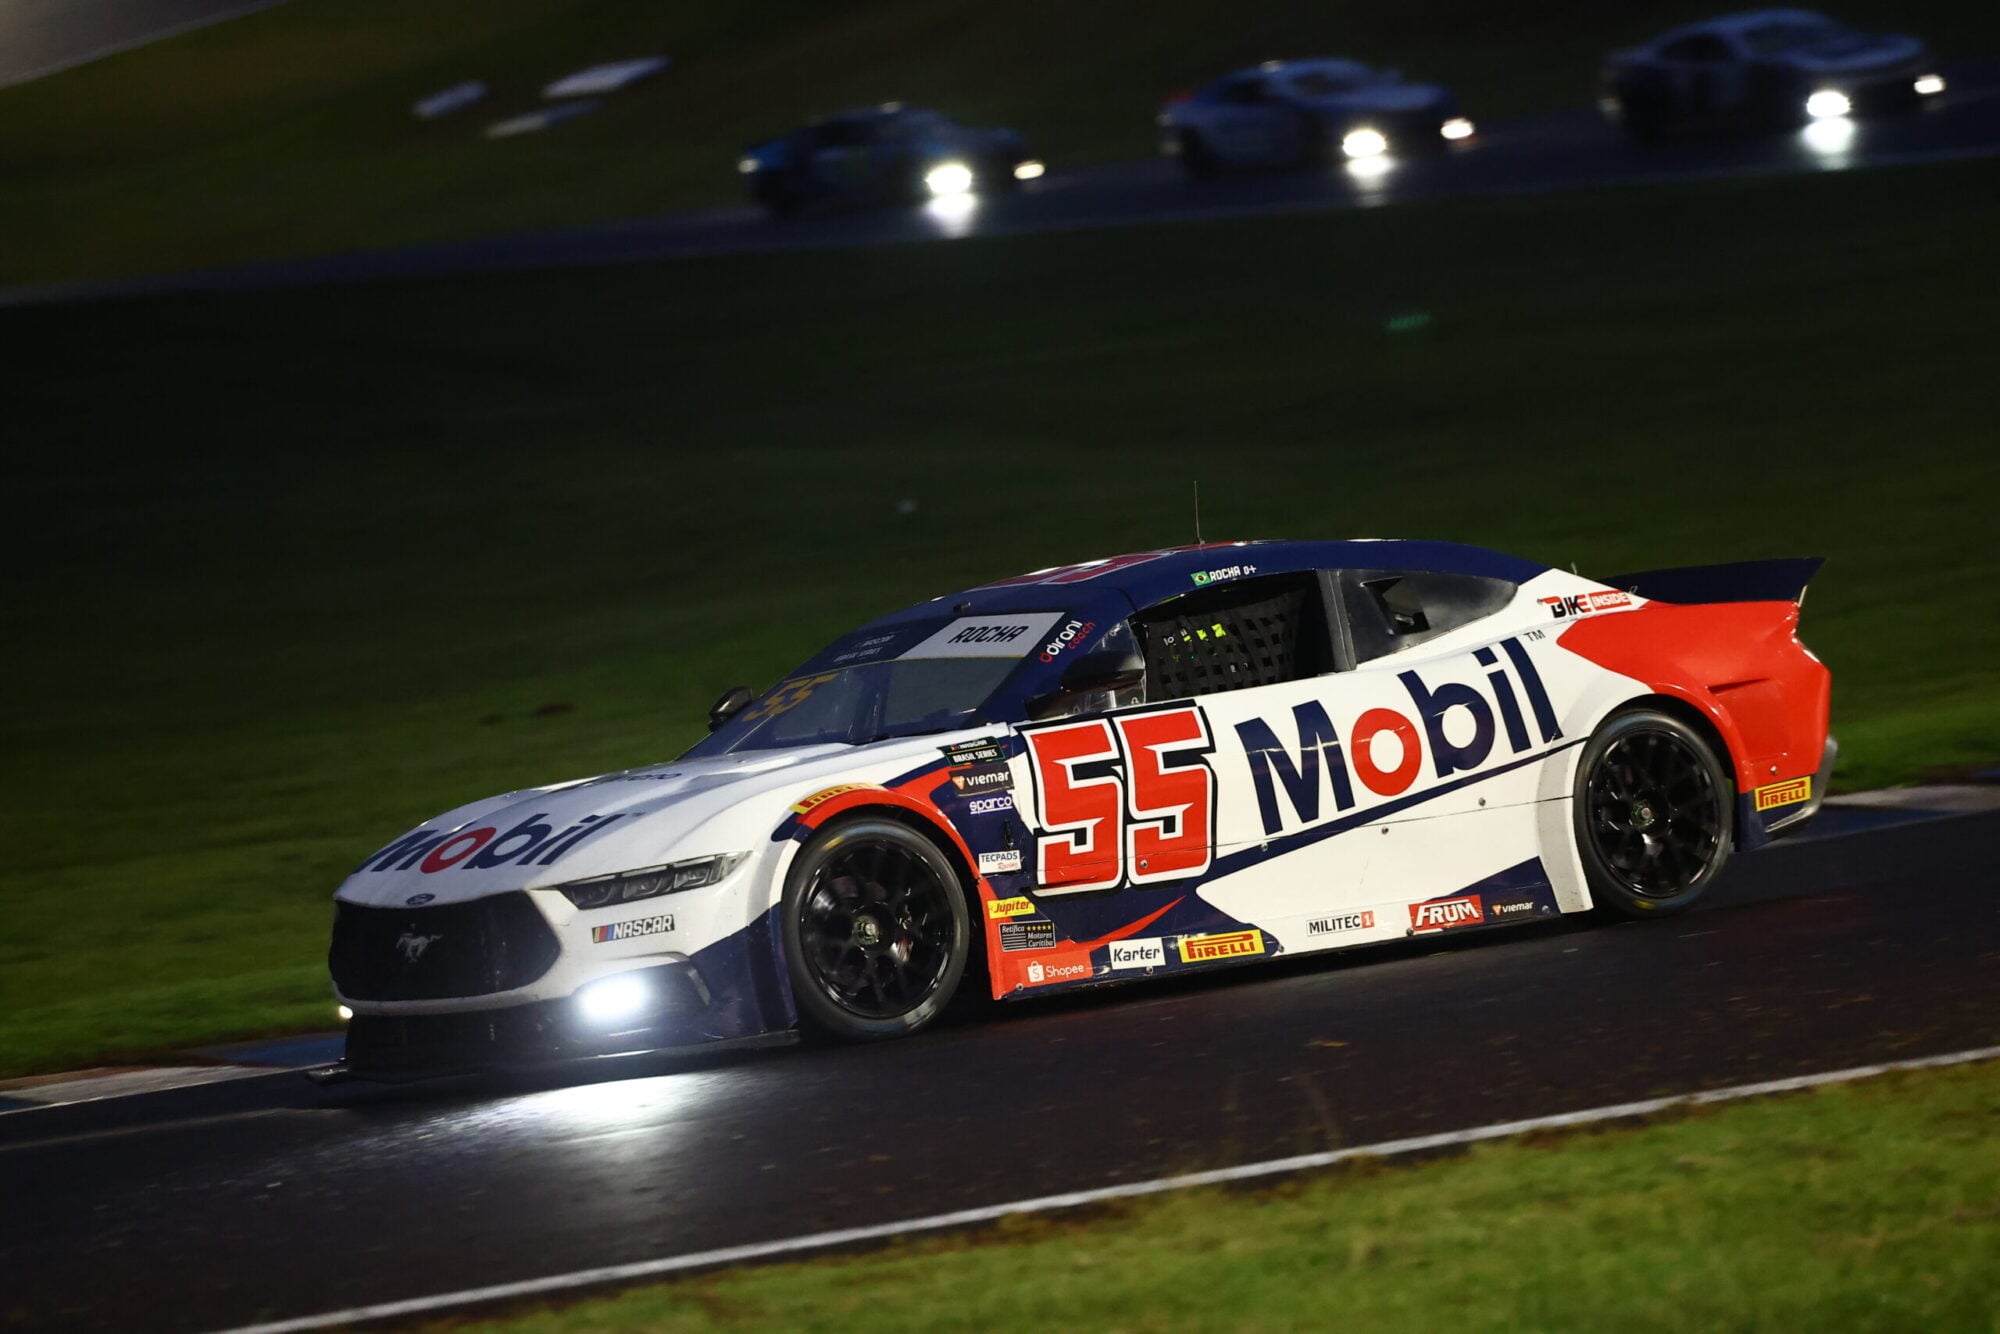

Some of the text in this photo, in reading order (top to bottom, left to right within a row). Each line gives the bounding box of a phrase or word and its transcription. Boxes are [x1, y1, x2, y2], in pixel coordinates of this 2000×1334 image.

[1209, 565, 1241, 582] ROCHA
[1542, 593, 1592, 618] BIKE
[948, 625, 1030, 644] ROCHA
[1233, 629, 1564, 836] Mobil TM
[952, 748, 998, 763] BRASIL SERIES
[966, 771, 1010, 786] viemar
[1022, 704, 1214, 896] 55
[1757, 779, 1807, 808] PIRELLI
[968, 796, 1013, 815] sparco
[353, 812, 627, 874] Mobil
[981, 852, 1018, 863] TECPADS
[993, 900, 1031, 915] Jupiter
[1416, 898, 1480, 928] FRUM
[1502, 901, 1534, 914] viemar
[611, 914, 673, 941] NASCAR
[1308, 915, 1361, 935] MILITEC
[1027, 931, 1053, 940] Motores
[1027, 938, 1054, 948] Curitiba
[1113, 946, 1160, 963] Karter
[1185, 932, 1255, 960] PIRELLI
[1045, 963, 1085, 978] Shopee
